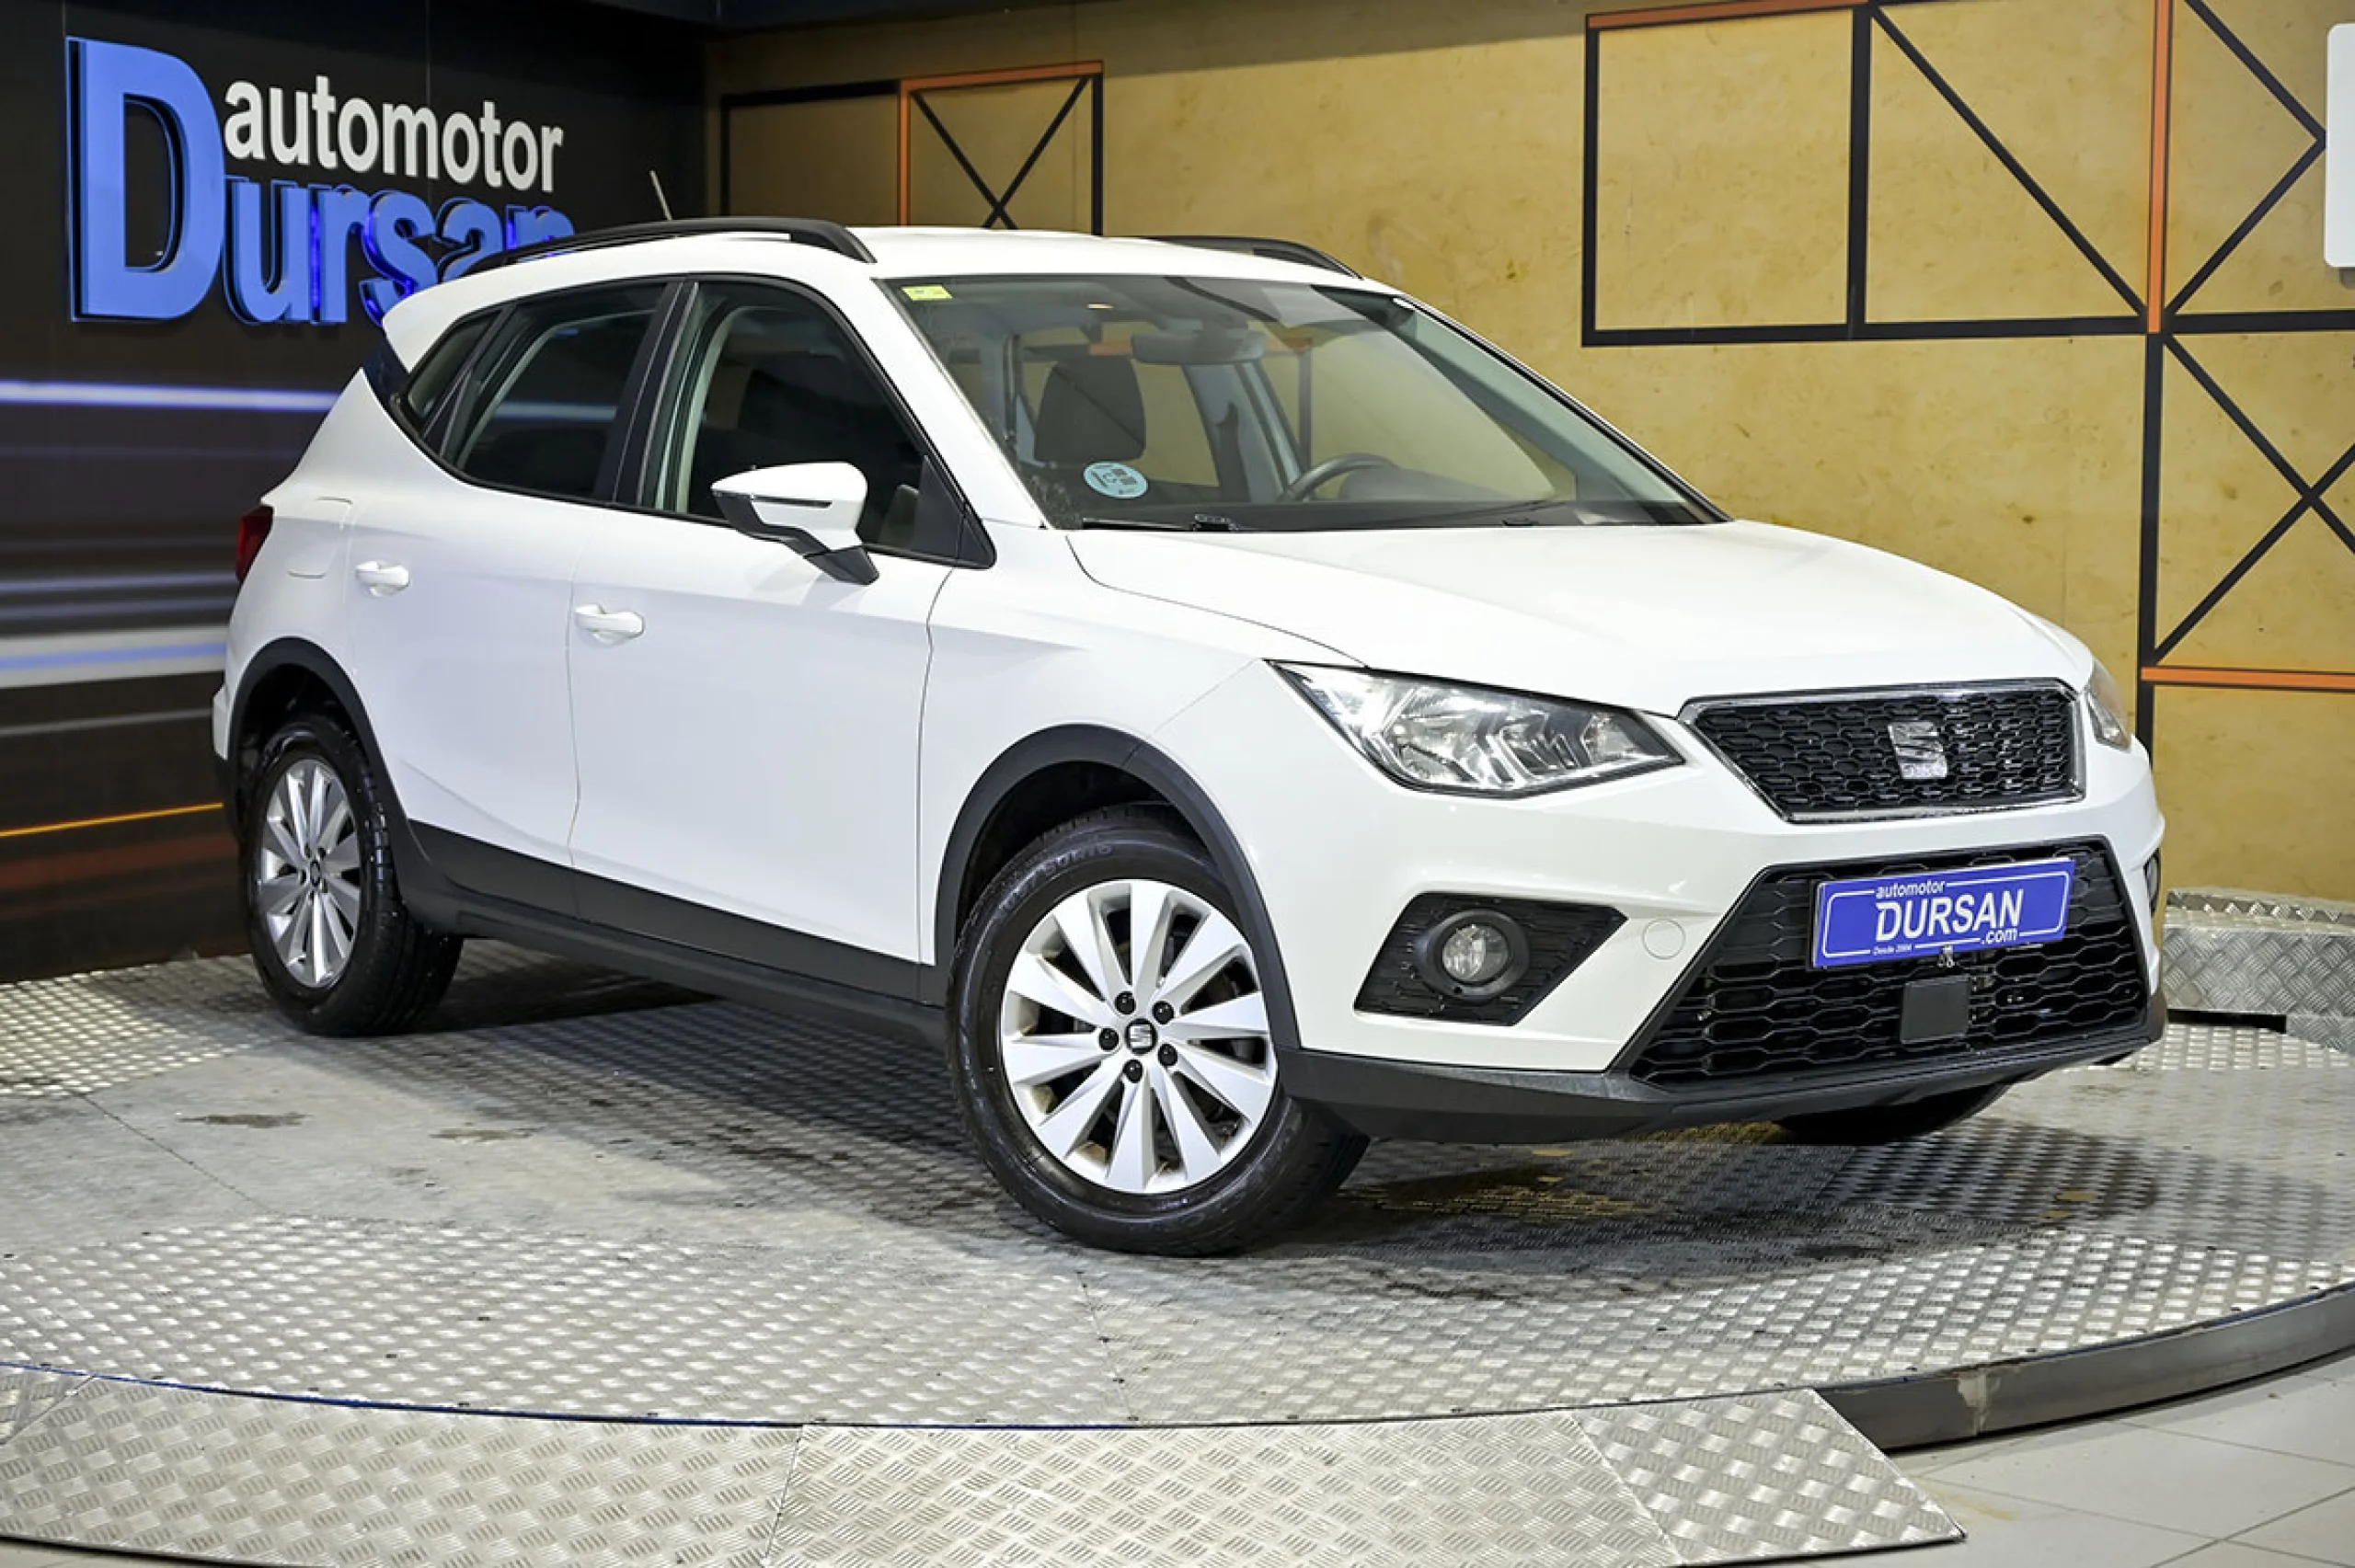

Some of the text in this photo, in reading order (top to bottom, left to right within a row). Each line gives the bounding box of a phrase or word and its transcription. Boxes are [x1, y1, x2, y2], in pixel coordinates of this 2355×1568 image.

[224, 74, 564, 193] automotor
[1875, 878, 1946, 899] automotor
[1874, 888, 2025, 943] DURSAN
[1981, 927, 2019, 945] .com
